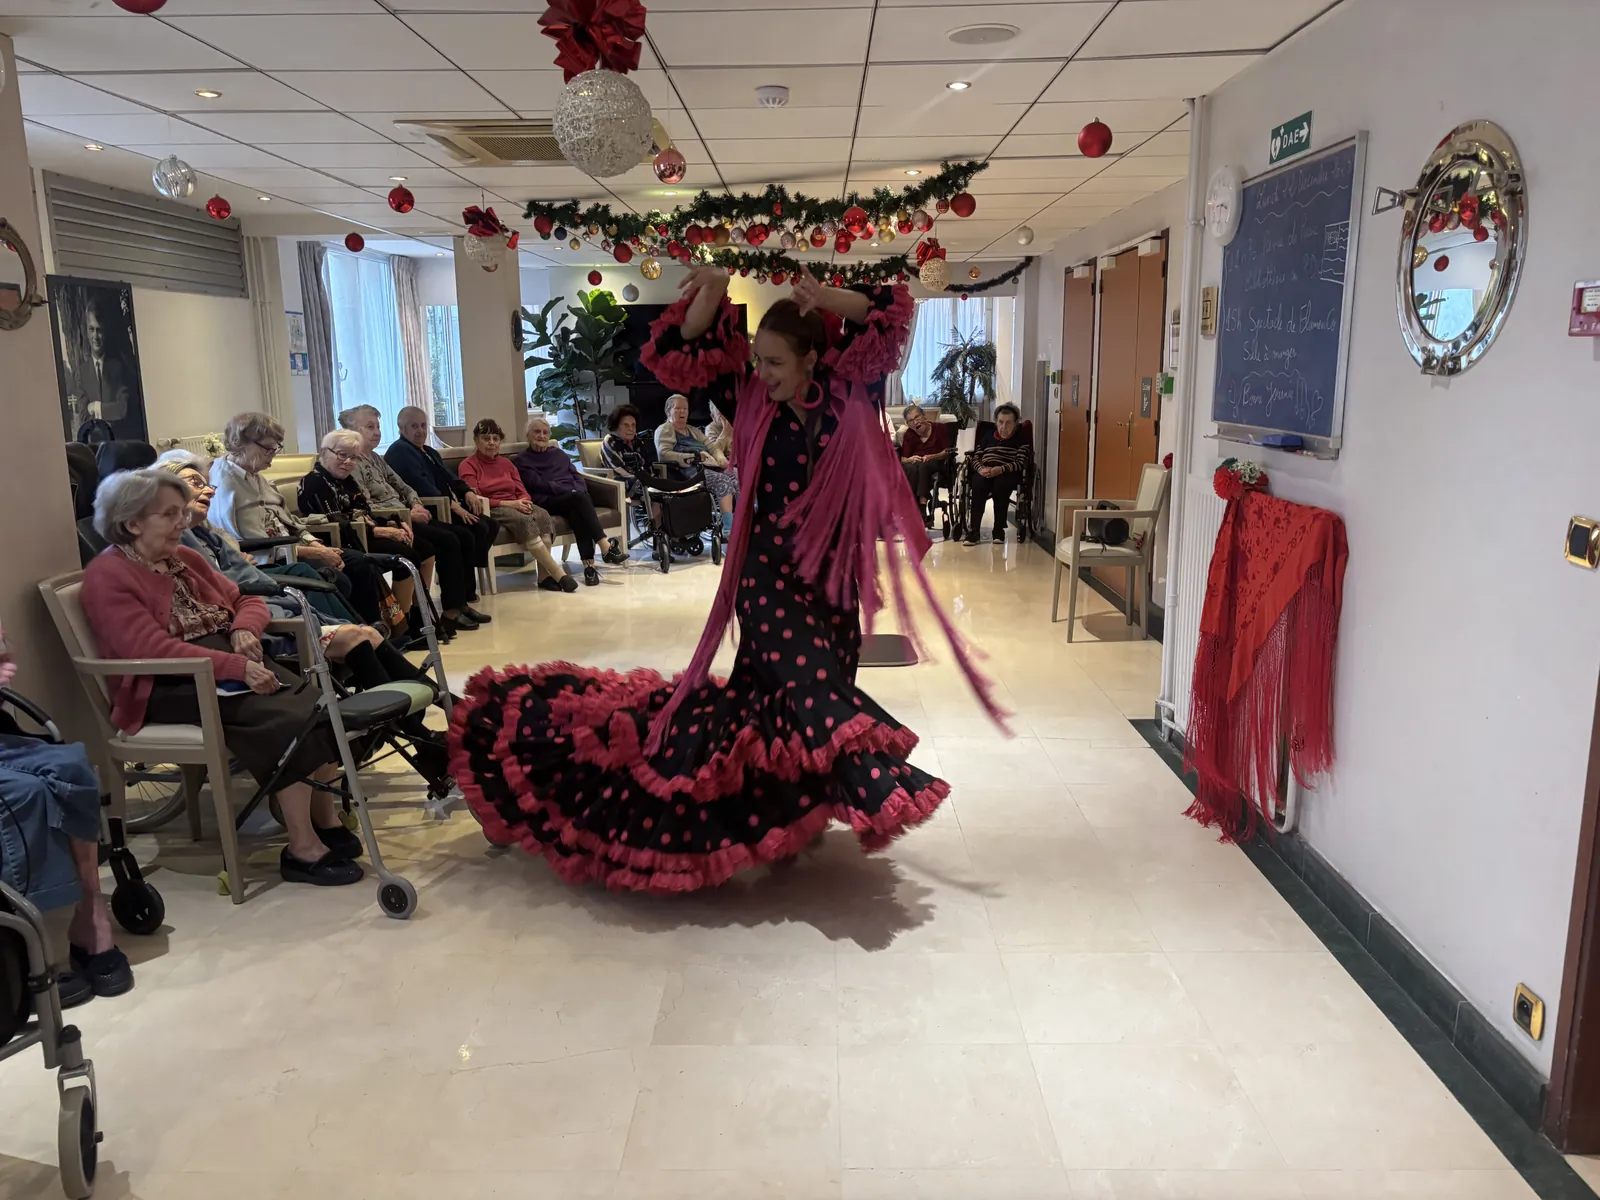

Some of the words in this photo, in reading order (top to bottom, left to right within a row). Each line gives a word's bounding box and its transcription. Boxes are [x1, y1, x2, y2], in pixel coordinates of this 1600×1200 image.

[1283, 129, 1299, 149] DAE
[1226, 307, 1242, 333] 15h
[1286, 305, 1296, 333] de
[1243, 338, 1261, 362] Salle
[1264, 344, 1270, 361] à
